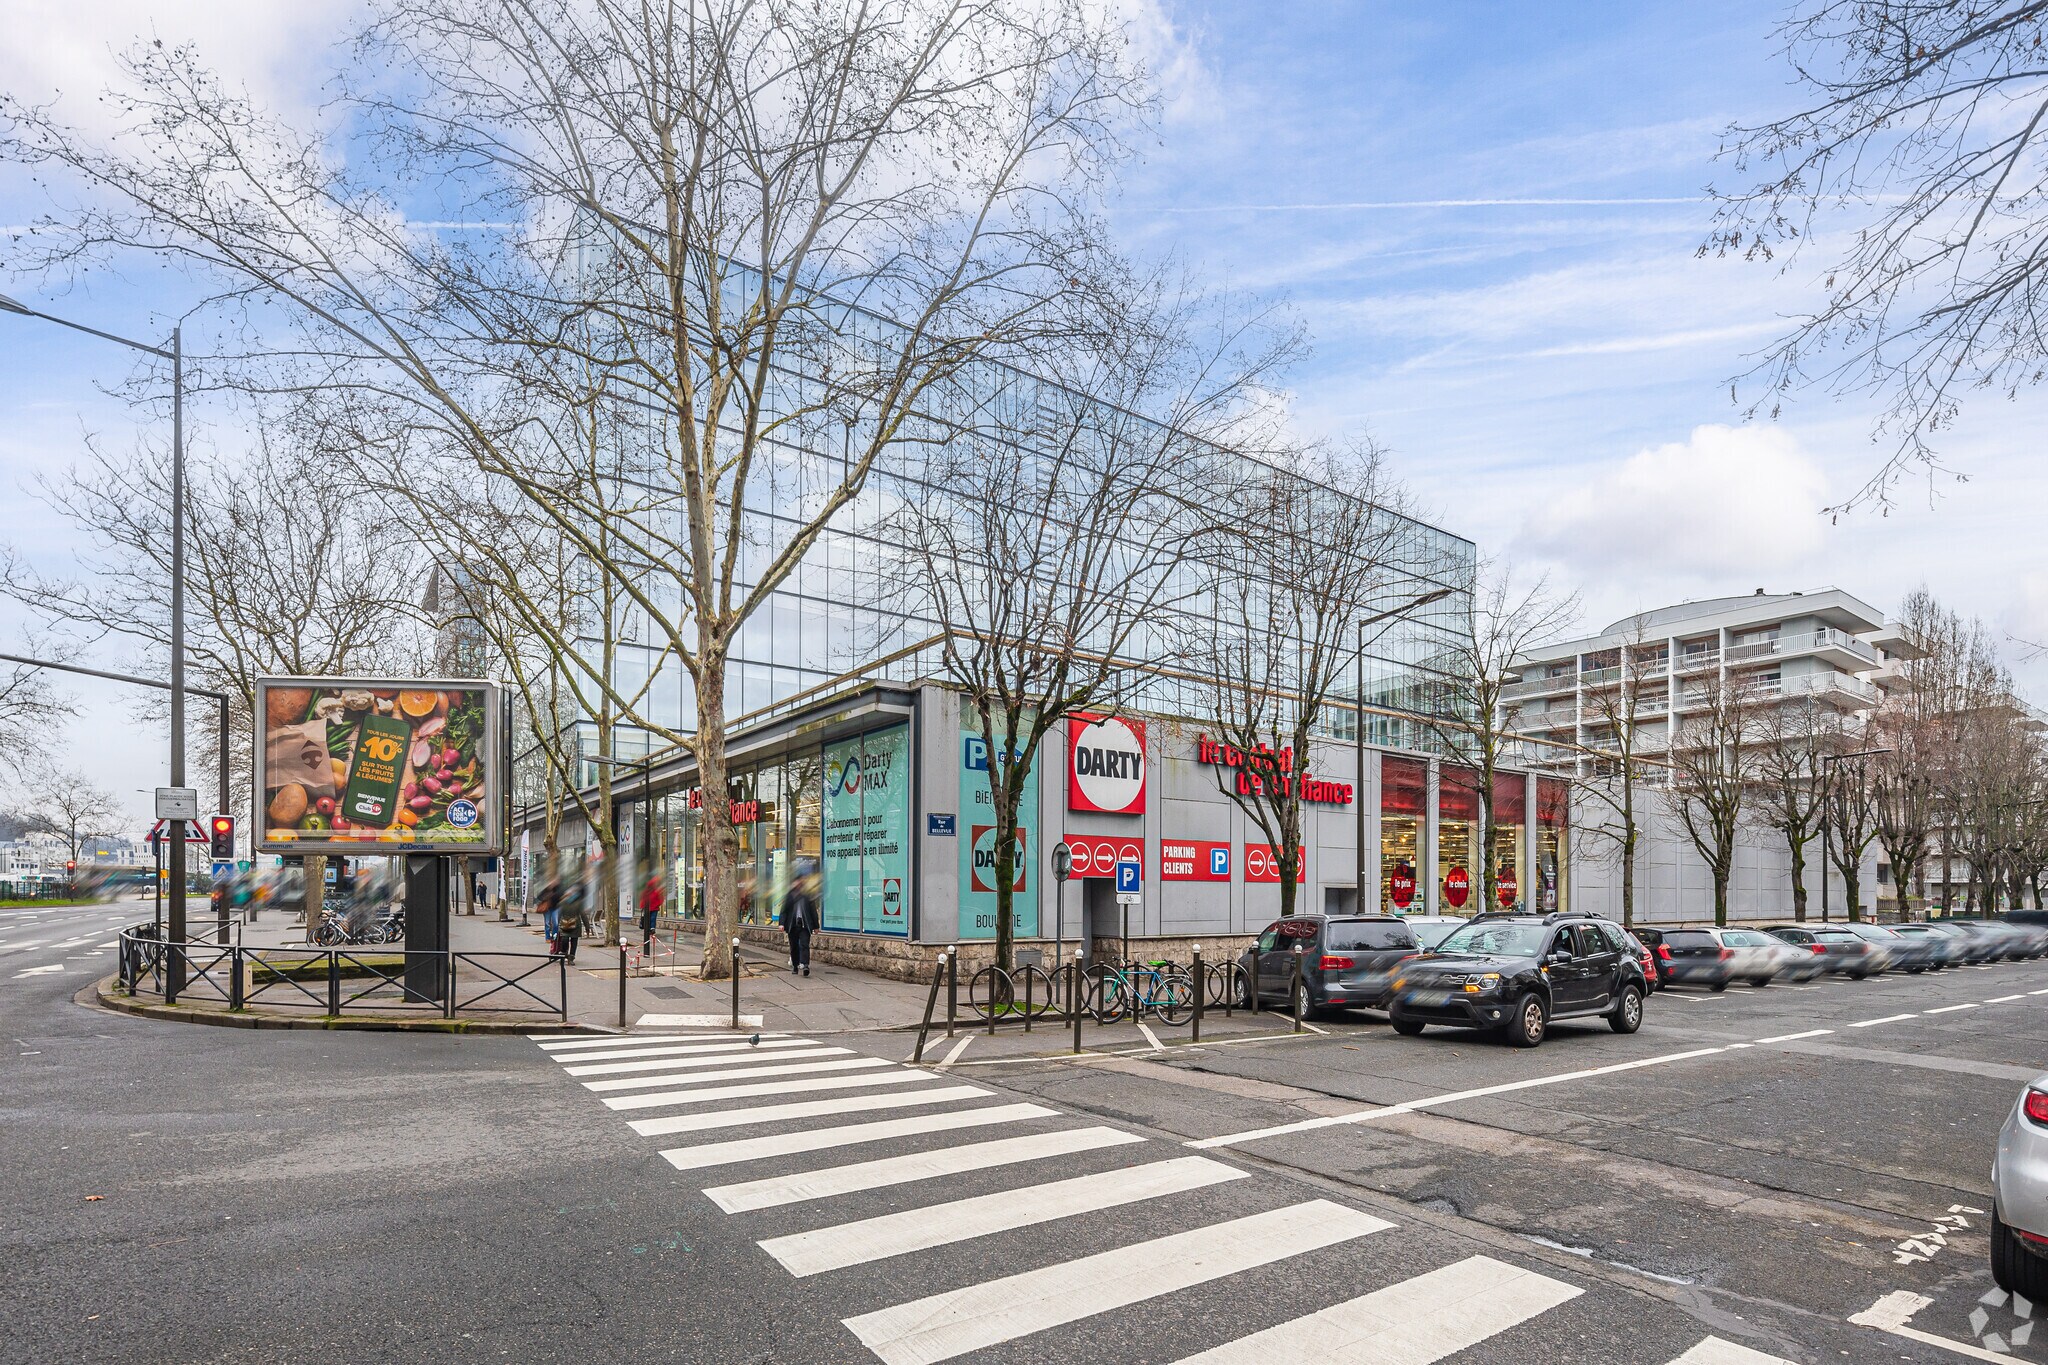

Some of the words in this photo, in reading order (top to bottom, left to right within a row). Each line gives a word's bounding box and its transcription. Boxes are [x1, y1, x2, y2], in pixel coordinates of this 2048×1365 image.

[389, 733, 404, 741] JOURS
[360, 736, 403, 762] -10%
[1199, 733, 1220, 764] le
[361, 760, 375, 768] SUR
[376, 763, 394, 771] TOUS
[864, 749, 892, 771] Darty
[1077, 746, 1141, 780] DARTY
[371, 768, 394, 778] FRUITS
[864, 770, 888, 791] MAX
[357, 793, 386, 803] BIENVENUE
[868, 814, 883, 827] pour
[826, 832, 854, 844] entretenir
[854, 831, 861, 841] et
[863, 829, 888, 843] réparer
[826, 849, 837, 858] vos
[837, 846, 867, 860] appareils
[868, 846, 877, 856] en
[878, 842, 899, 855] illimité
[1163, 845, 1196, 859] PARKING
[975, 849, 1023, 869] DAY
[1215, 851, 1227, 872] P
[1163, 861, 1193, 875] CLIENTS
[1123, 867, 1135, 887] P
[1394, 878, 1401, 888] le
[1401, 878, 1411, 890] prix
[1448, 879, 1454, 888] le
[1454, 879, 1467, 888] choix
[1502, 880, 1517, 889] service
[884, 892, 900, 903] DARTY
